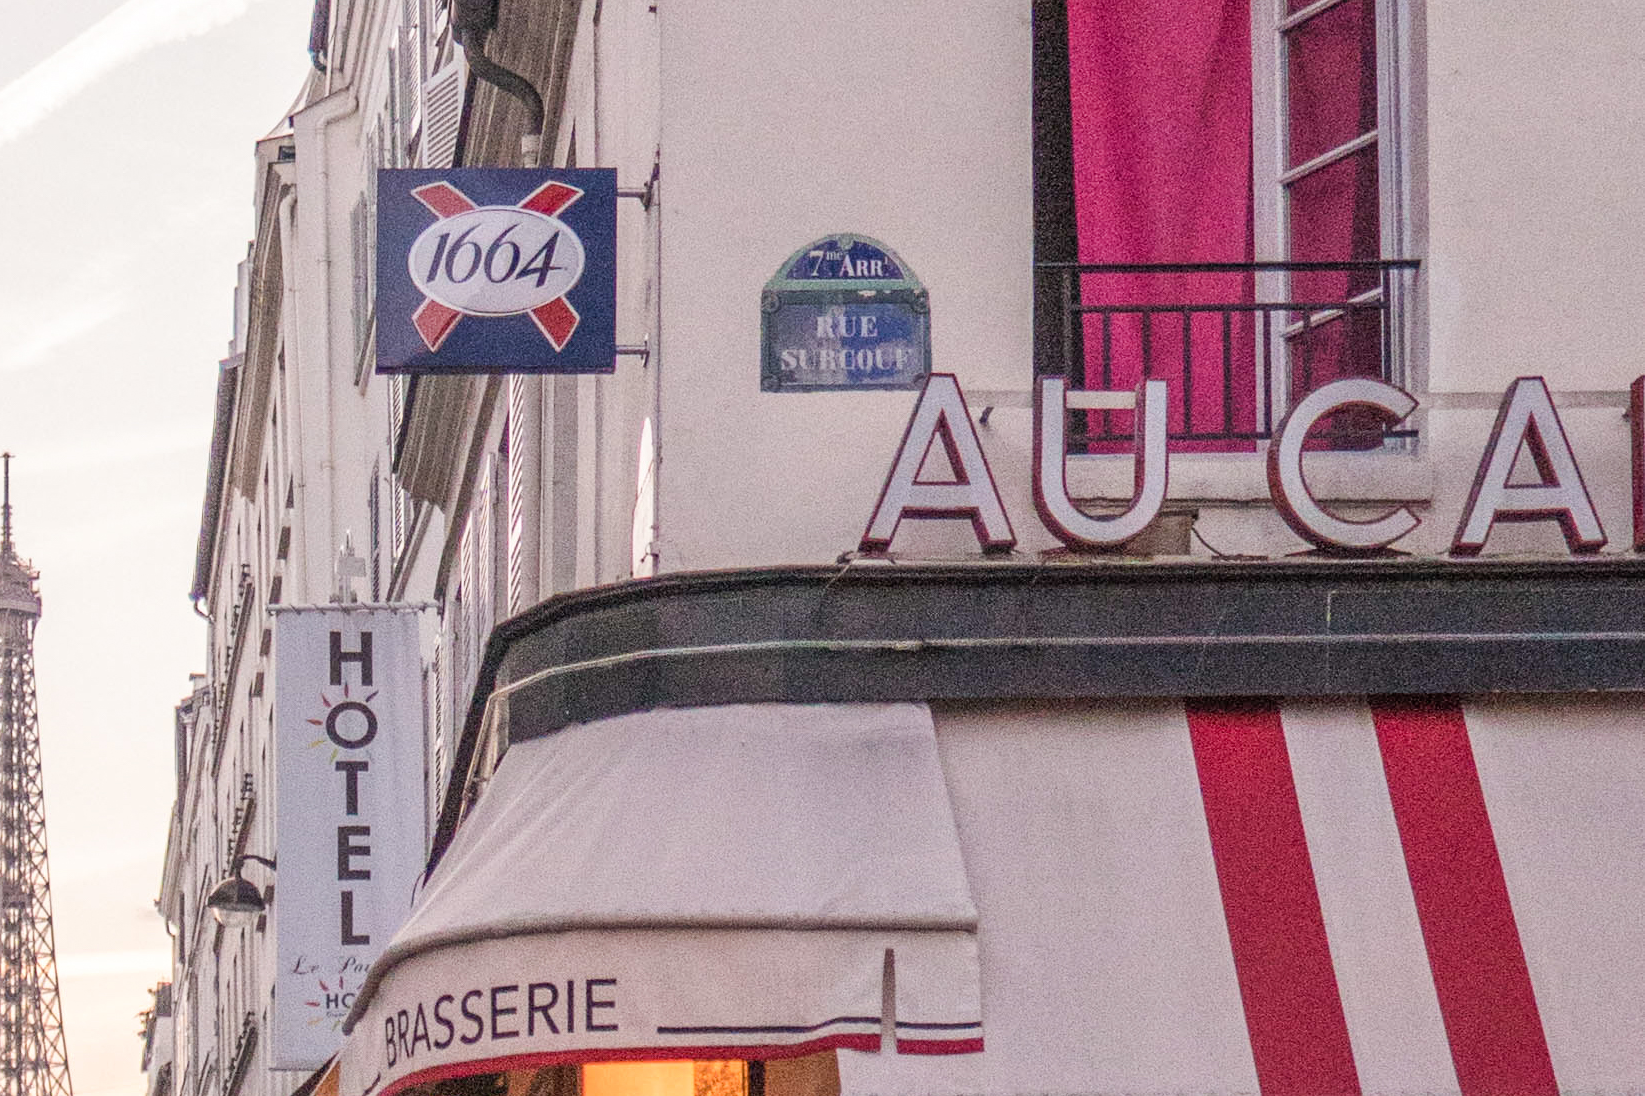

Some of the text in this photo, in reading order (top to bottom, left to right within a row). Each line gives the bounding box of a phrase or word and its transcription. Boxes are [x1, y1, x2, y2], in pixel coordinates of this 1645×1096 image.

[427, 222, 562, 289] 1664
[781, 349, 912, 371] SURCOUF
[816, 316, 879, 338] RUE
[858, 372, 1645, 556] AU CA
[325, 631, 378, 946] HOTEL
[293, 955, 319, 975] Le
[384, 979, 619, 1069] BRASSERIE
